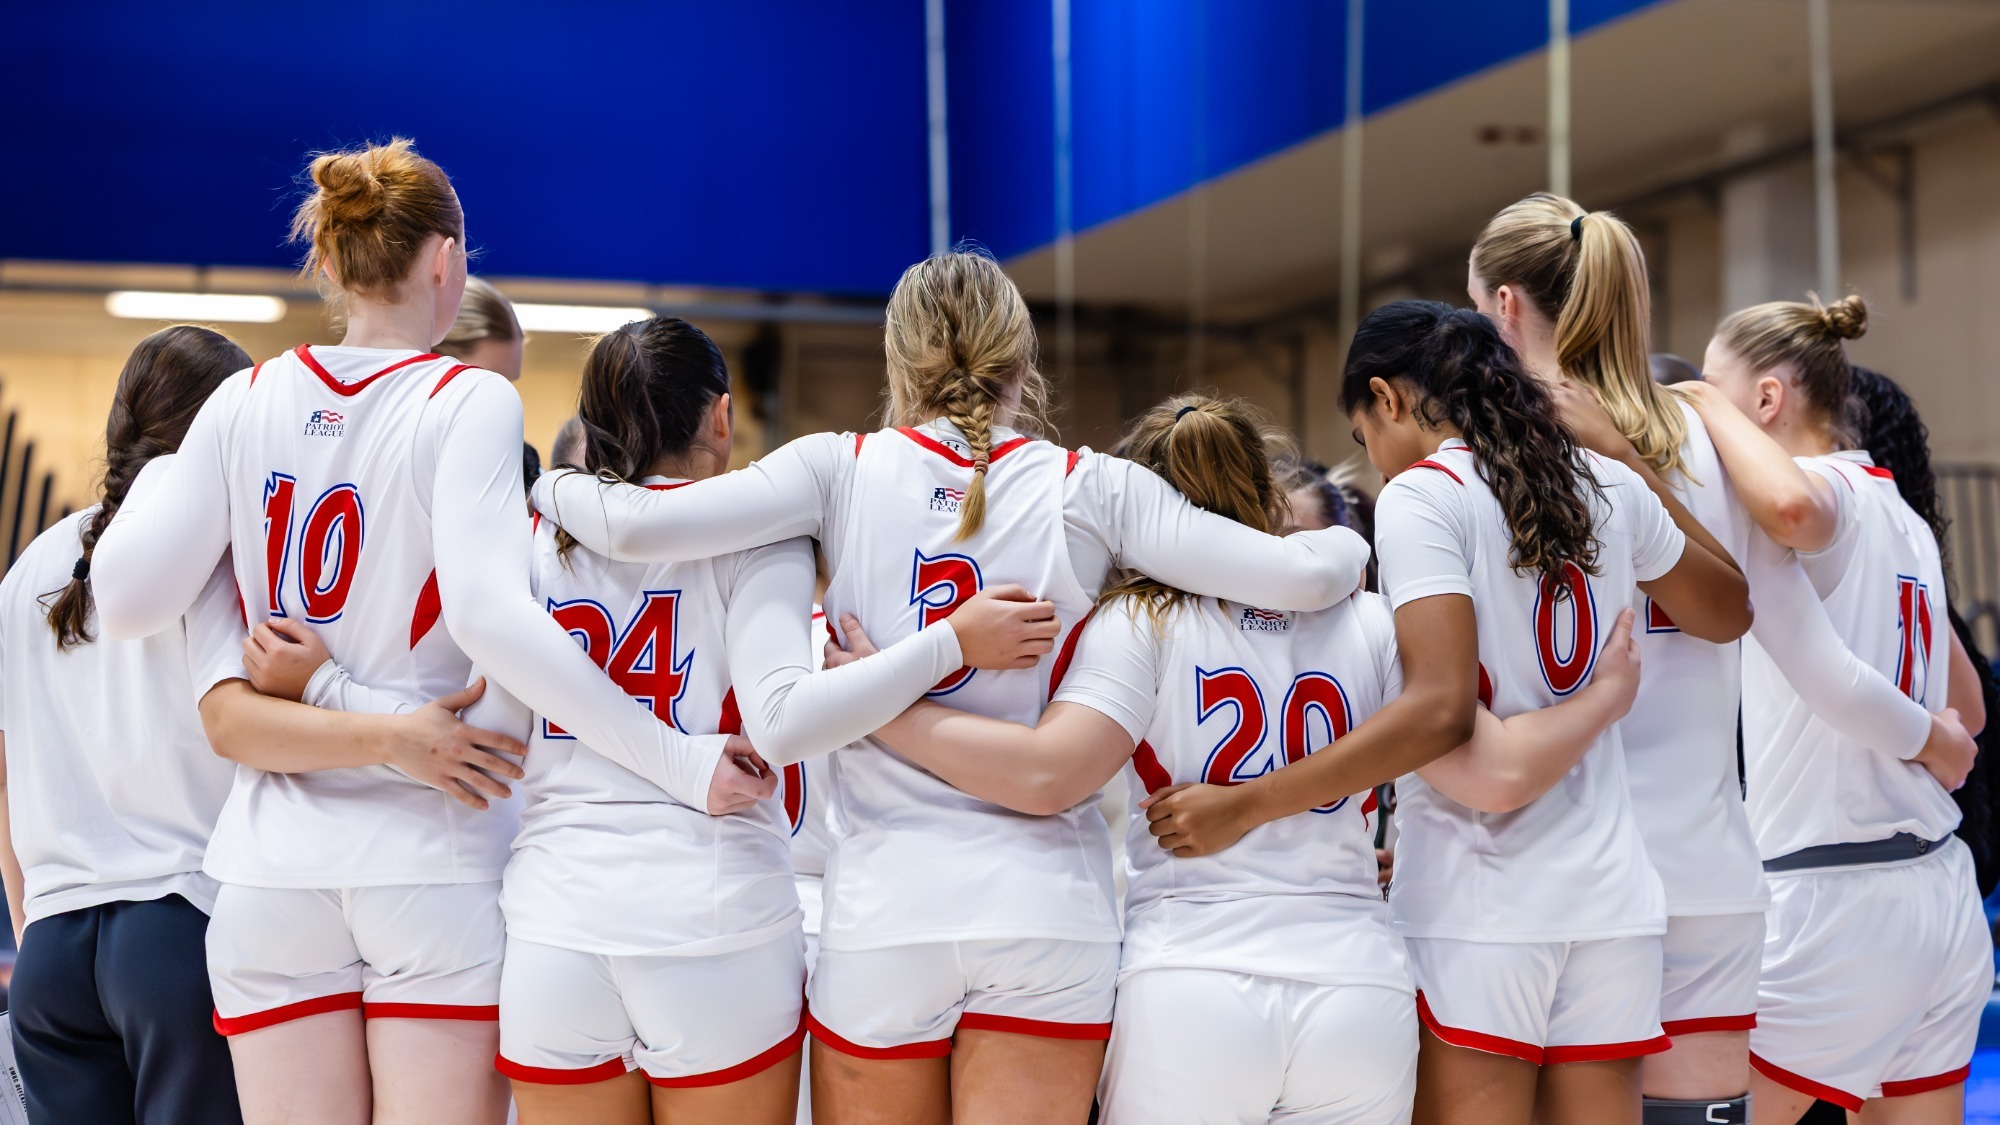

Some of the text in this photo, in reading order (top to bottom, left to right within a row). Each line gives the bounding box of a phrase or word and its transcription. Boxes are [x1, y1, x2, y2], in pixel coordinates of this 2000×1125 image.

[263, 471, 364, 624] 10
[543, 590, 695, 739] 24
[1533, 559, 1598, 696] 0
[1196, 665, 1352, 814] 20
